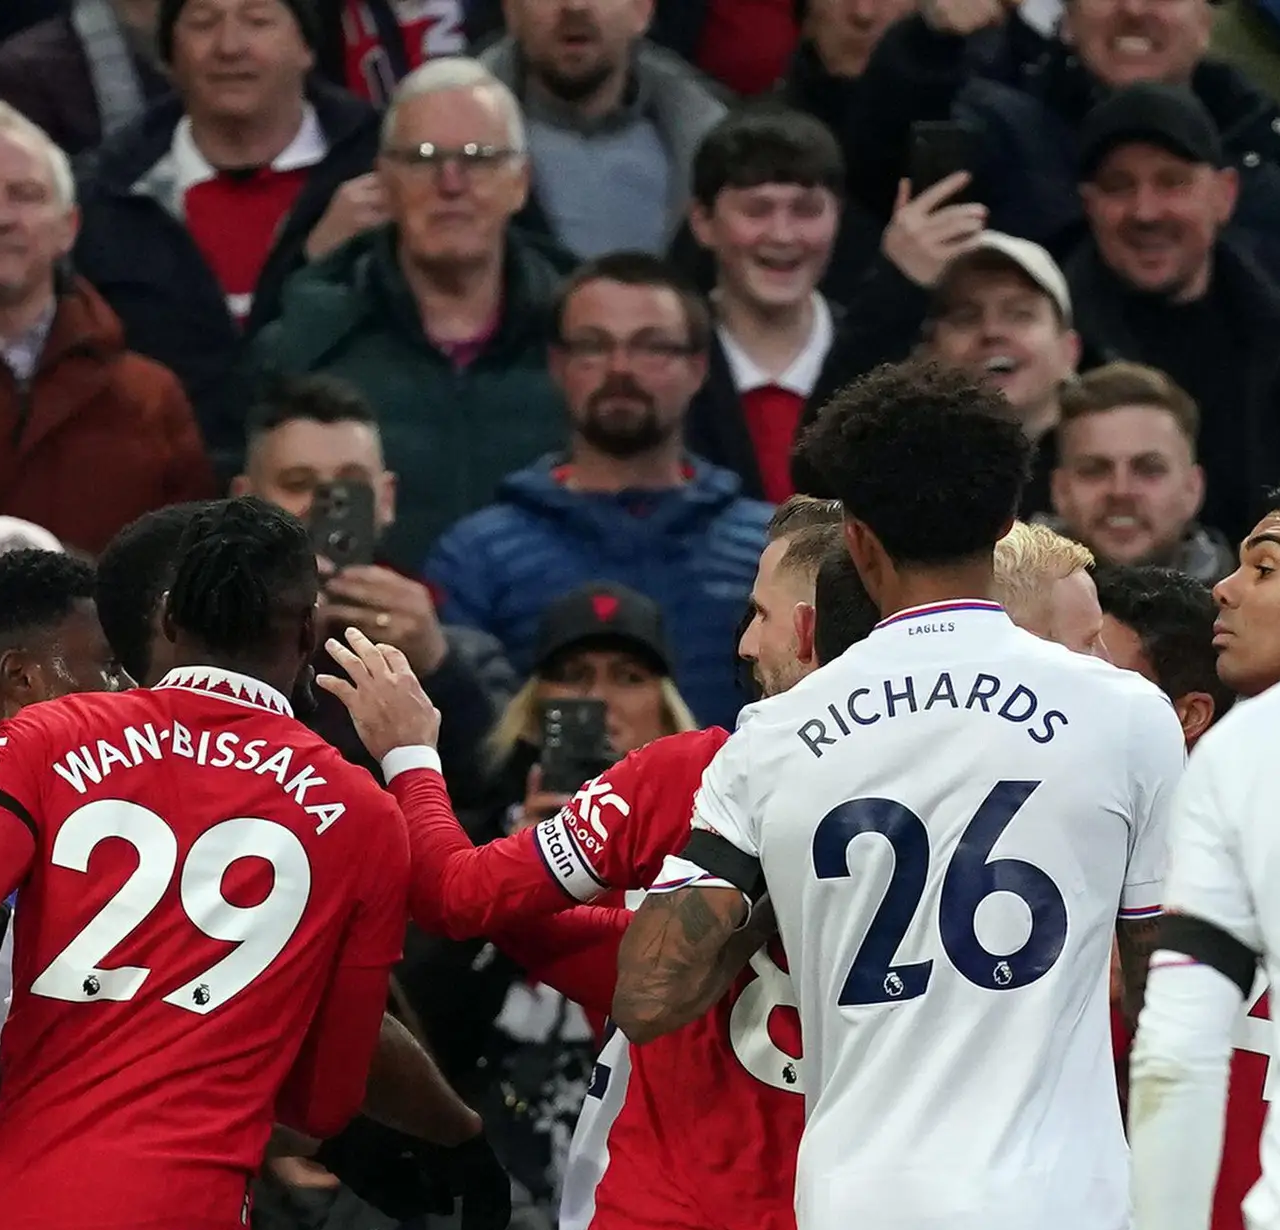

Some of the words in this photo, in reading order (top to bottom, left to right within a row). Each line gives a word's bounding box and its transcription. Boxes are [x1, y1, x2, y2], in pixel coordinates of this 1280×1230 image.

[908, 621, 955, 636] EAGLES
[796, 672, 1069, 758] RICHARDS
[52, 720, 346, 836] WAN-BISSAKA
[540, 818, 576, 878] ptain
[812, 780, 1068, 1006] 26
[29, 798, 312, 1016] 29
